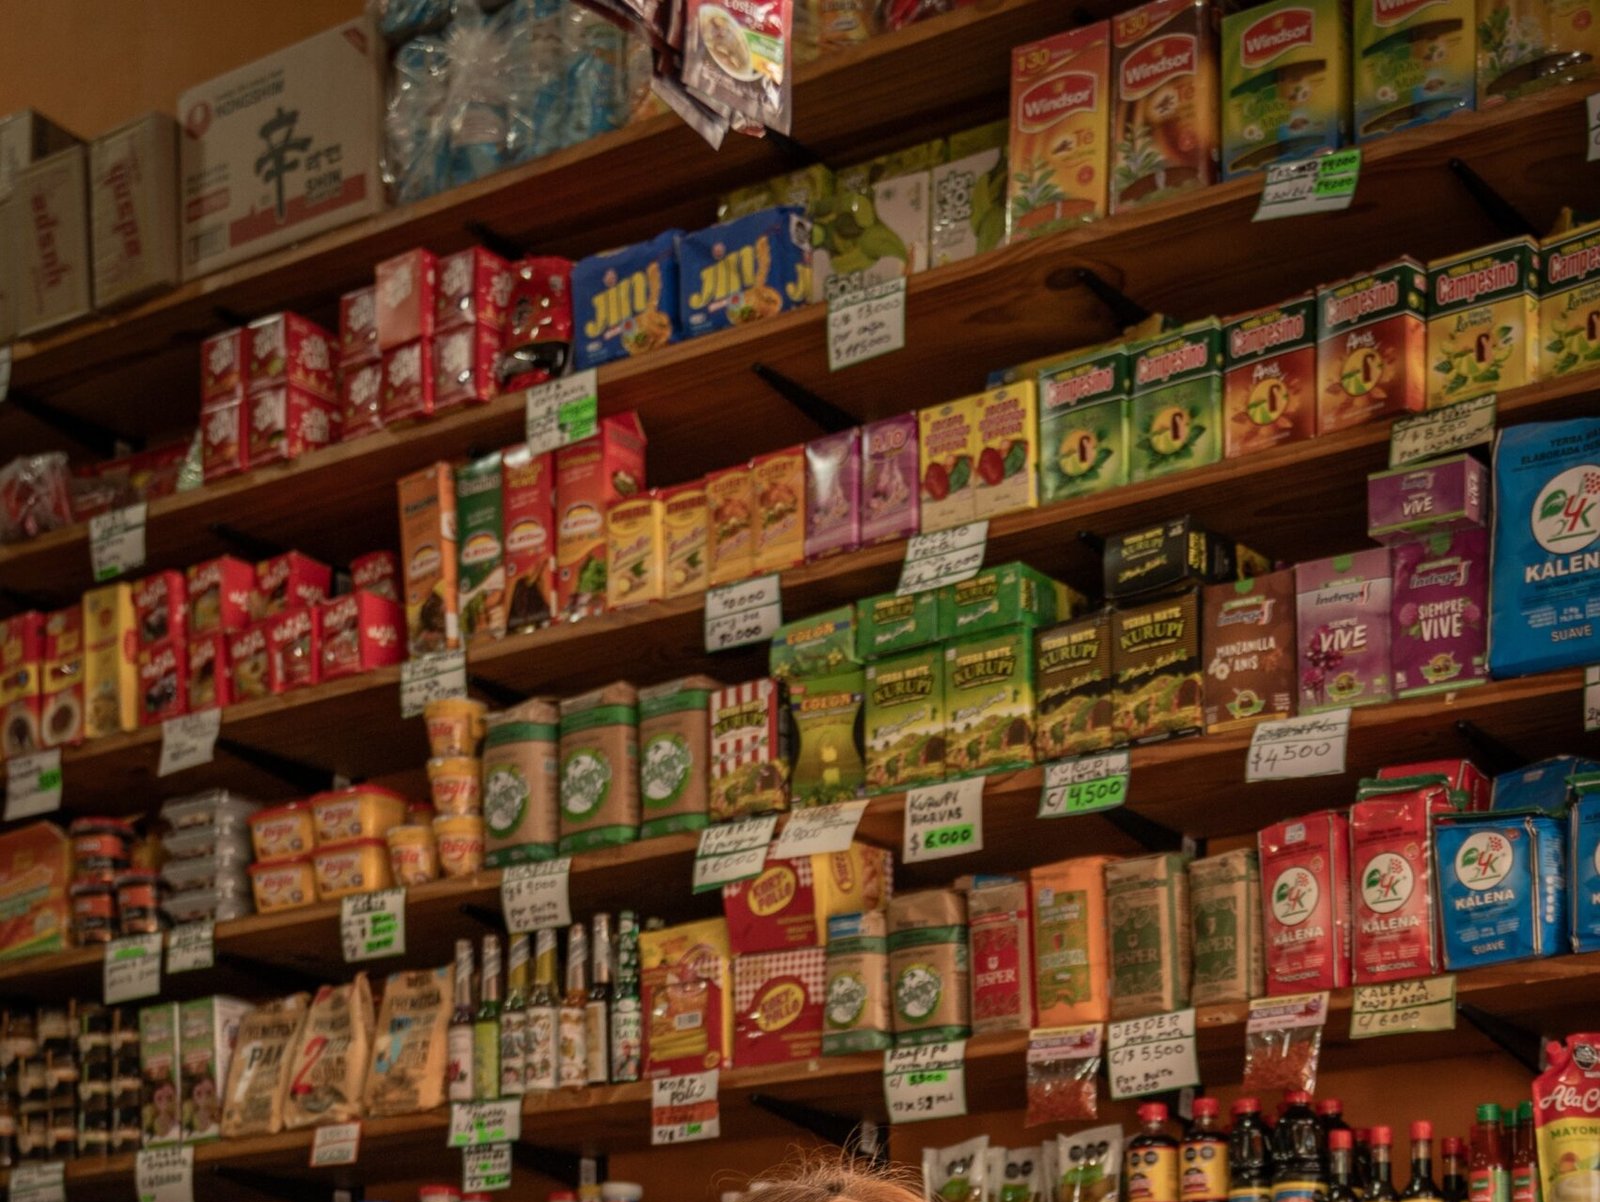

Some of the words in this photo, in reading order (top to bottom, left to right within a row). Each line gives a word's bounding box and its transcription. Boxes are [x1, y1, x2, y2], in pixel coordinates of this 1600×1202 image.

[1246, 22, 1311, 54] Windsor
[1125, 52, 1192, 85] Windsor
[1024, 89, 1091, 118] Windsor
[254, 105, 312, 219] 辛
[1436, 261, 1519, 306] Campesino
[1402, 496, 1433, 517] VIVE
[1319, 624, 1367, 653] VIVE
[1419, 616, 1462, 641] VIVE
[1550, 625, 1593, 644] SUAVE
[1454, 889, 1515, 912] KALENA
[1272, 926, 1325, 947] KALENA
[1361, 914, 1420, 936] KALENA
[1471, 939, 1505, 956] SUAVE
[1359, 979, 1427, 1001] KALENA
